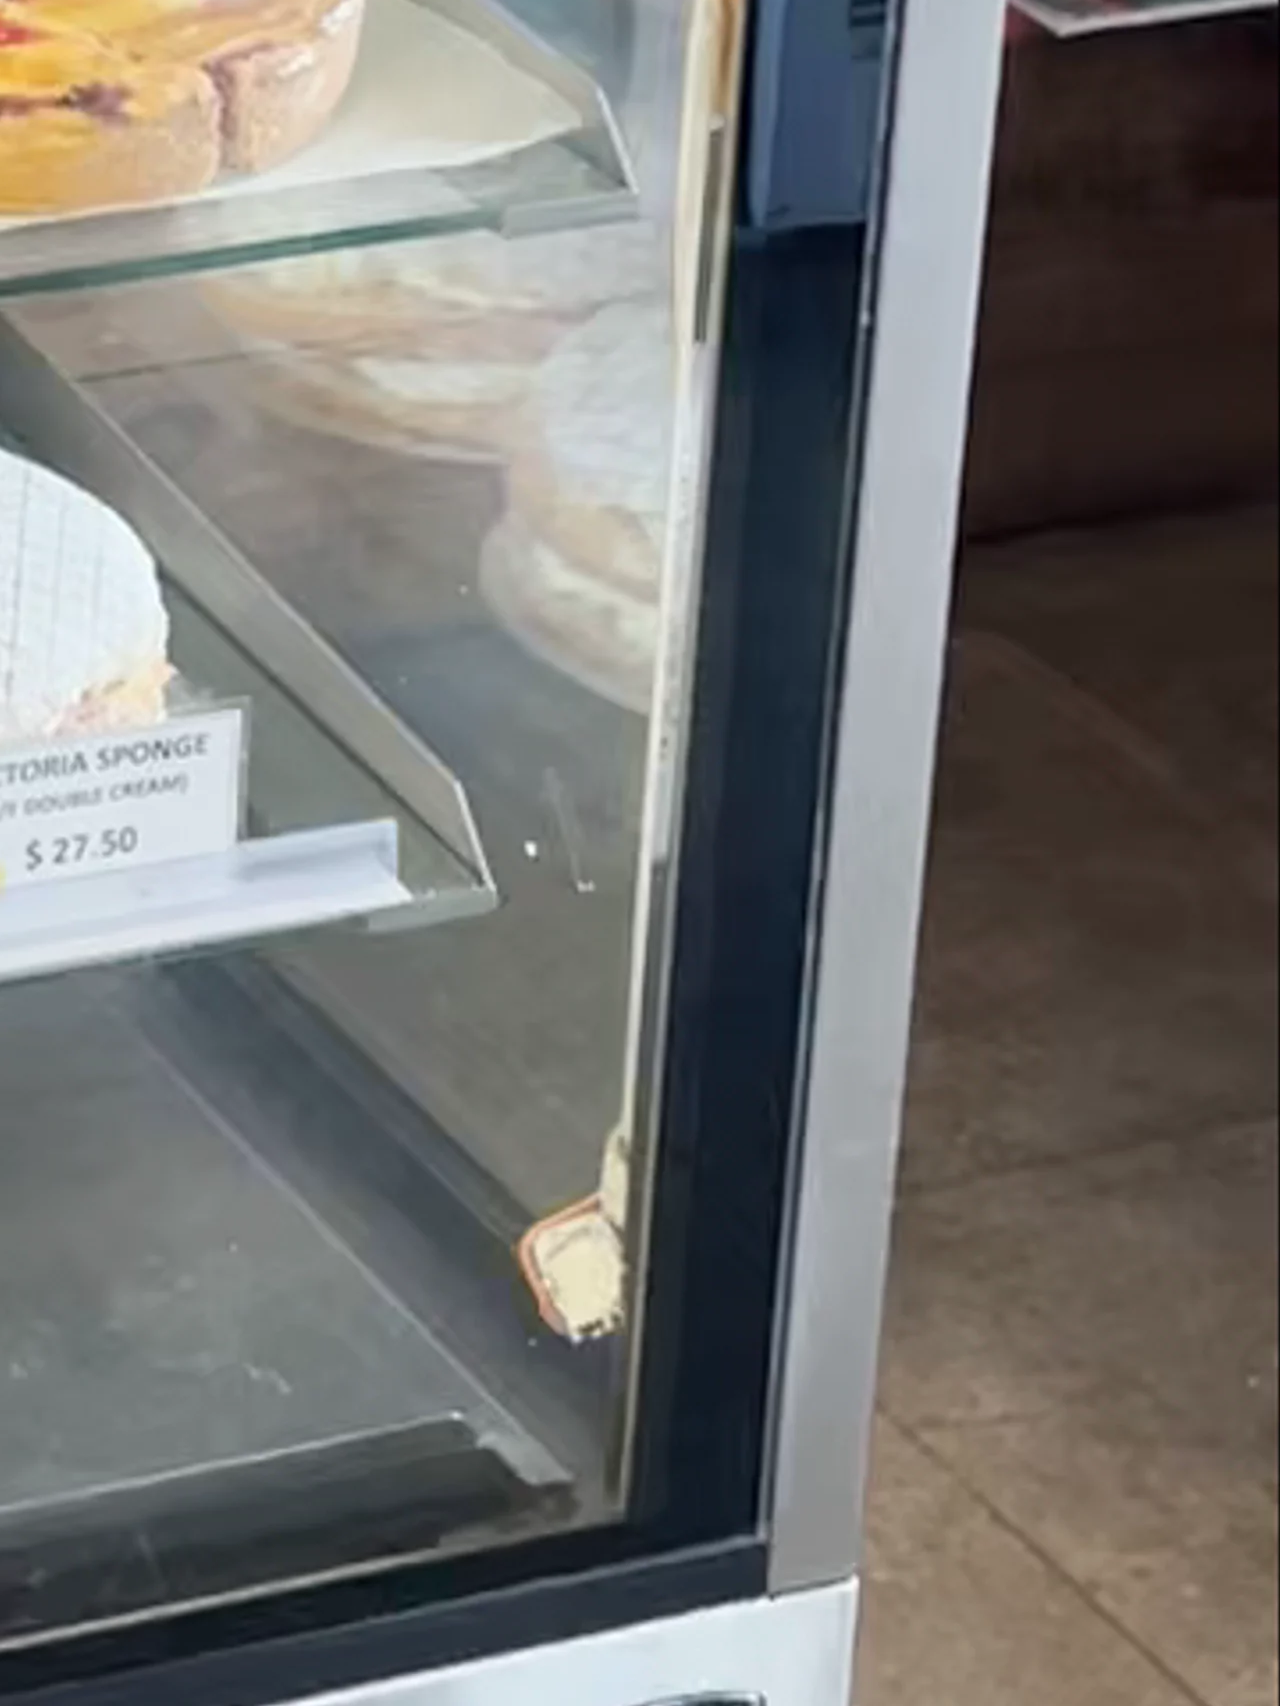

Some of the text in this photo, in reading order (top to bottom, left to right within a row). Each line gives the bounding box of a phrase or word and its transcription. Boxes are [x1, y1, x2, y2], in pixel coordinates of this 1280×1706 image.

[96, 732, 210, 770] SPONGE
[24, 786, 104, 817] DOUBLE
[109, 772, 189, 803] CREAM)
[24, 825, 139, 872] $ 27.50
